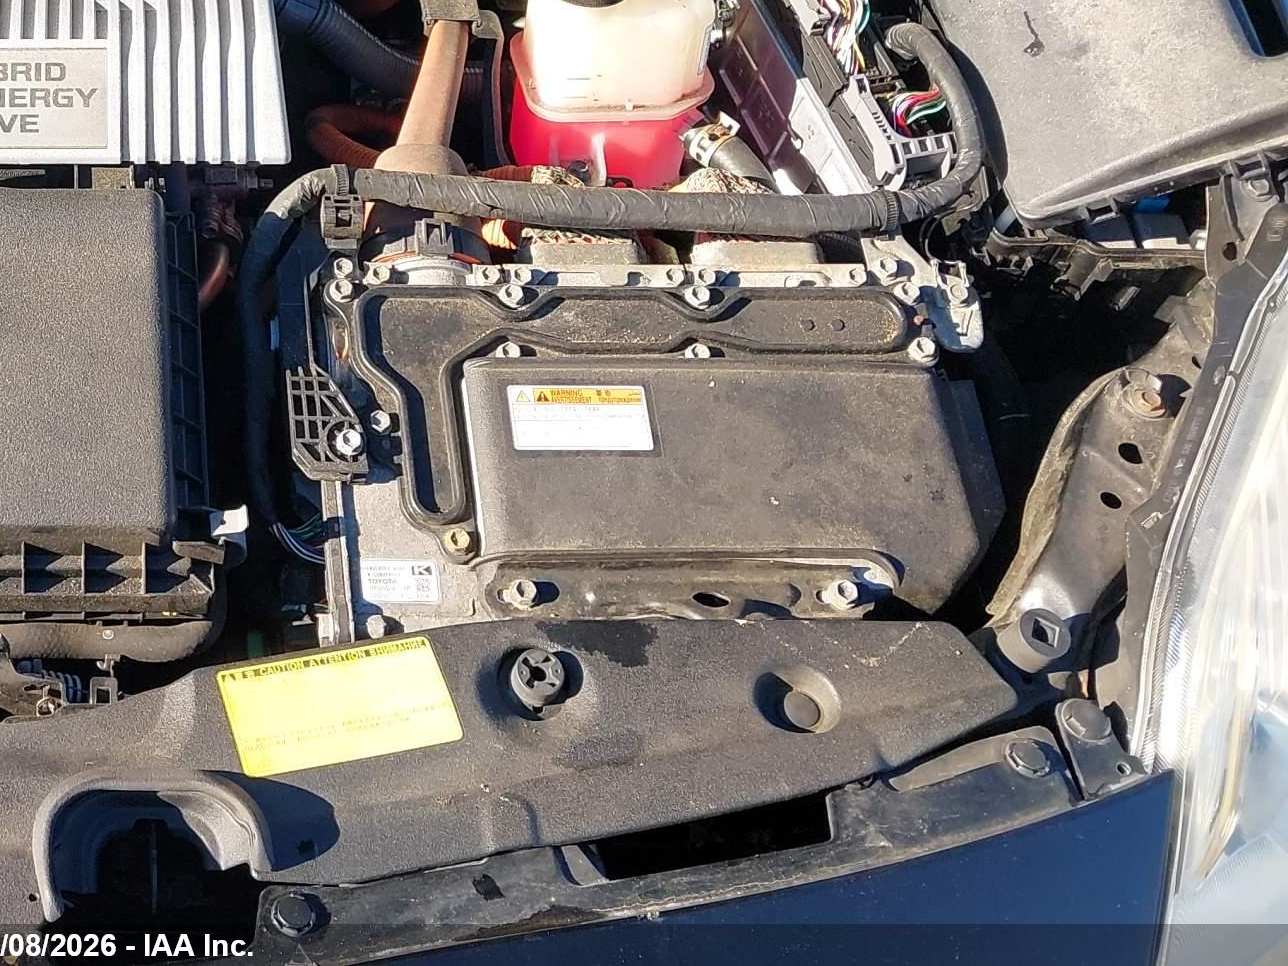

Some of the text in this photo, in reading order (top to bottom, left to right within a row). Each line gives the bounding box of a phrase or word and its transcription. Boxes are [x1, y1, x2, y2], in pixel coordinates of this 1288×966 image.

[550, 389, 583, 397] WARNING
[259, 660, 305, 676] CAUTION
[309, 649, 366, 668] ATTENTION
